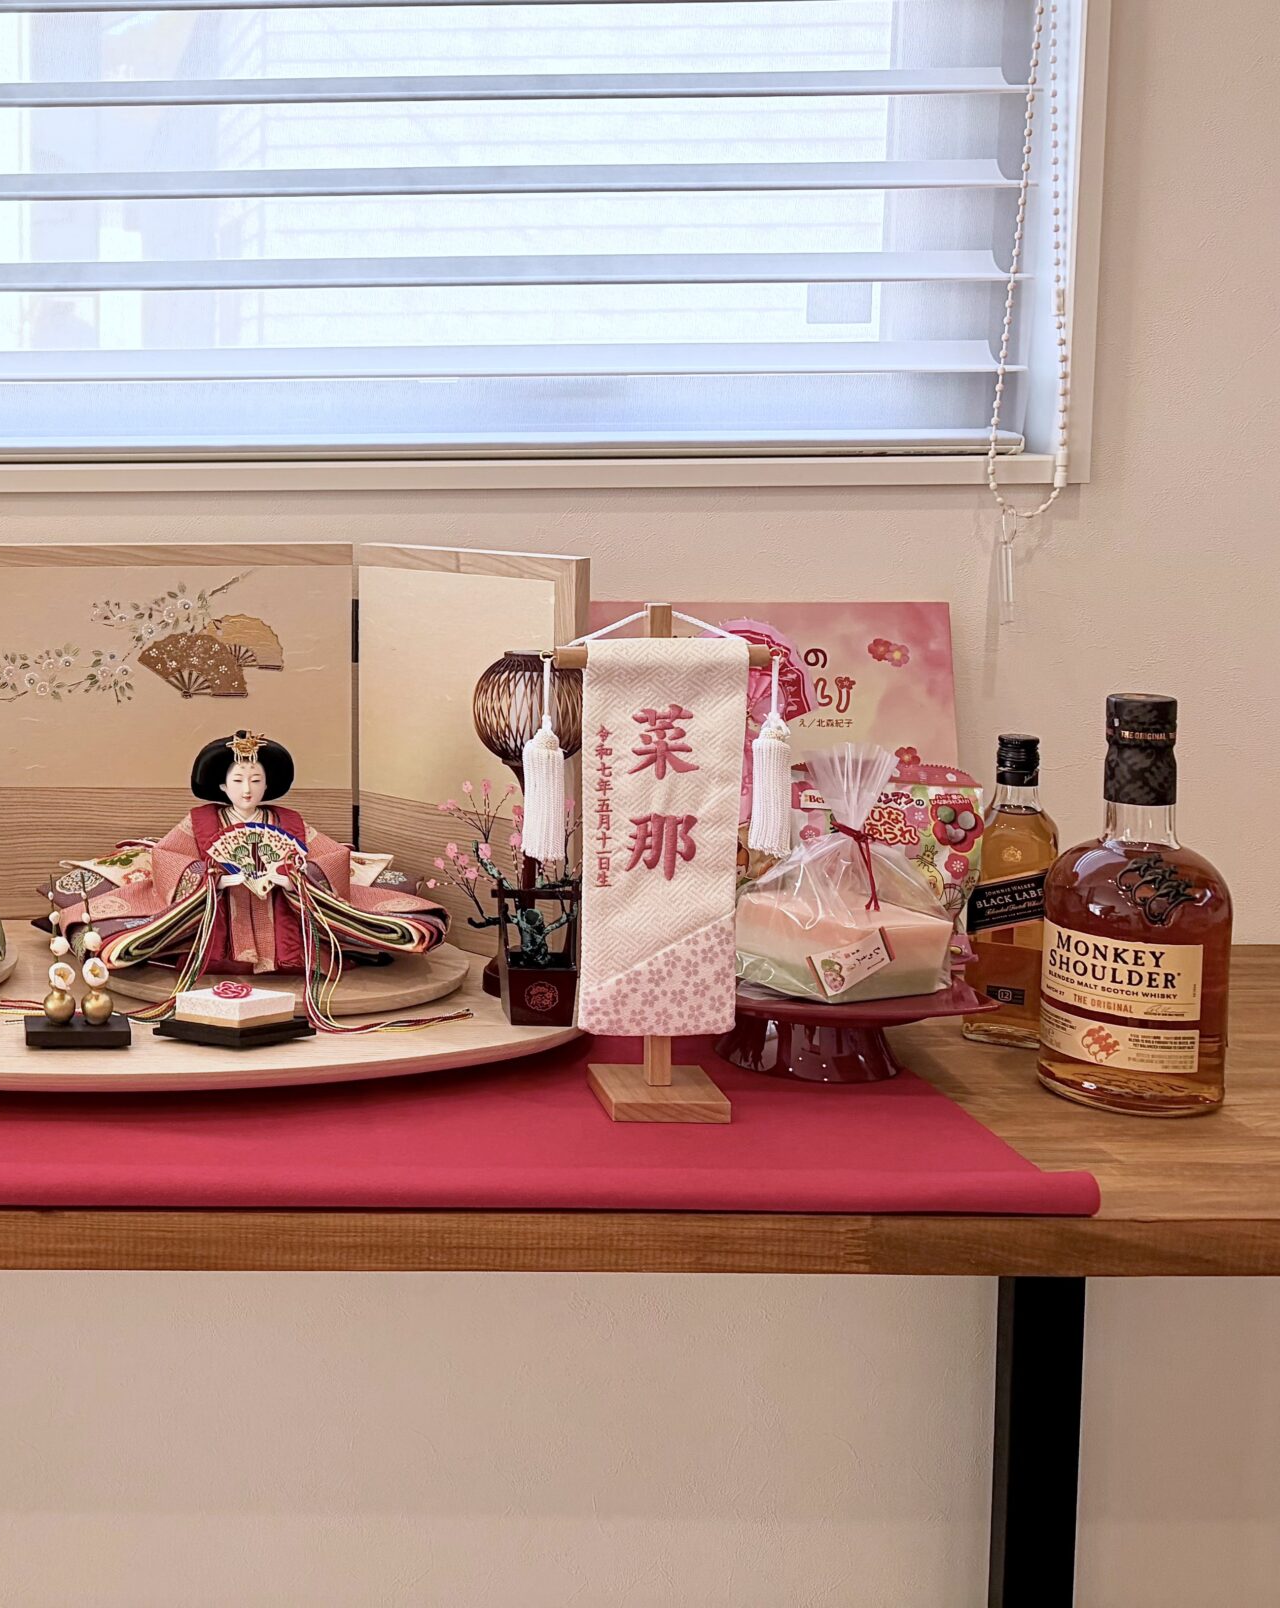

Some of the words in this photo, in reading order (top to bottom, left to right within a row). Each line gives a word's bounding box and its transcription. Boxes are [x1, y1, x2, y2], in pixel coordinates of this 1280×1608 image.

[595, 724, 613, 887] 令和七年五月十一日生
[625, 704, 700, 881] 菜那
[870, 808, 903, 824] ひな
[867, 822, 918, 844] あられ
[976, 894, 1013, 909] BLACK
[1015, 888, 1045, 901] LABE
[1056, 931, 1166, 968] MONKEY
[1049, 949, 1176, 989] SHOULDER
[1000, 991, 1011, 1000] 12
[1048, 969, 1075, 985] BLENDED
[1076, 979, 1098, 991] MALT
[1101, 986, 1139, 997] SCOTCH
[1141, 991, 1178, 1000] WHISKY
[1073, 993, 1088, 1005] THE
[1090, 998, 1134, 1014] ORIGINAL
